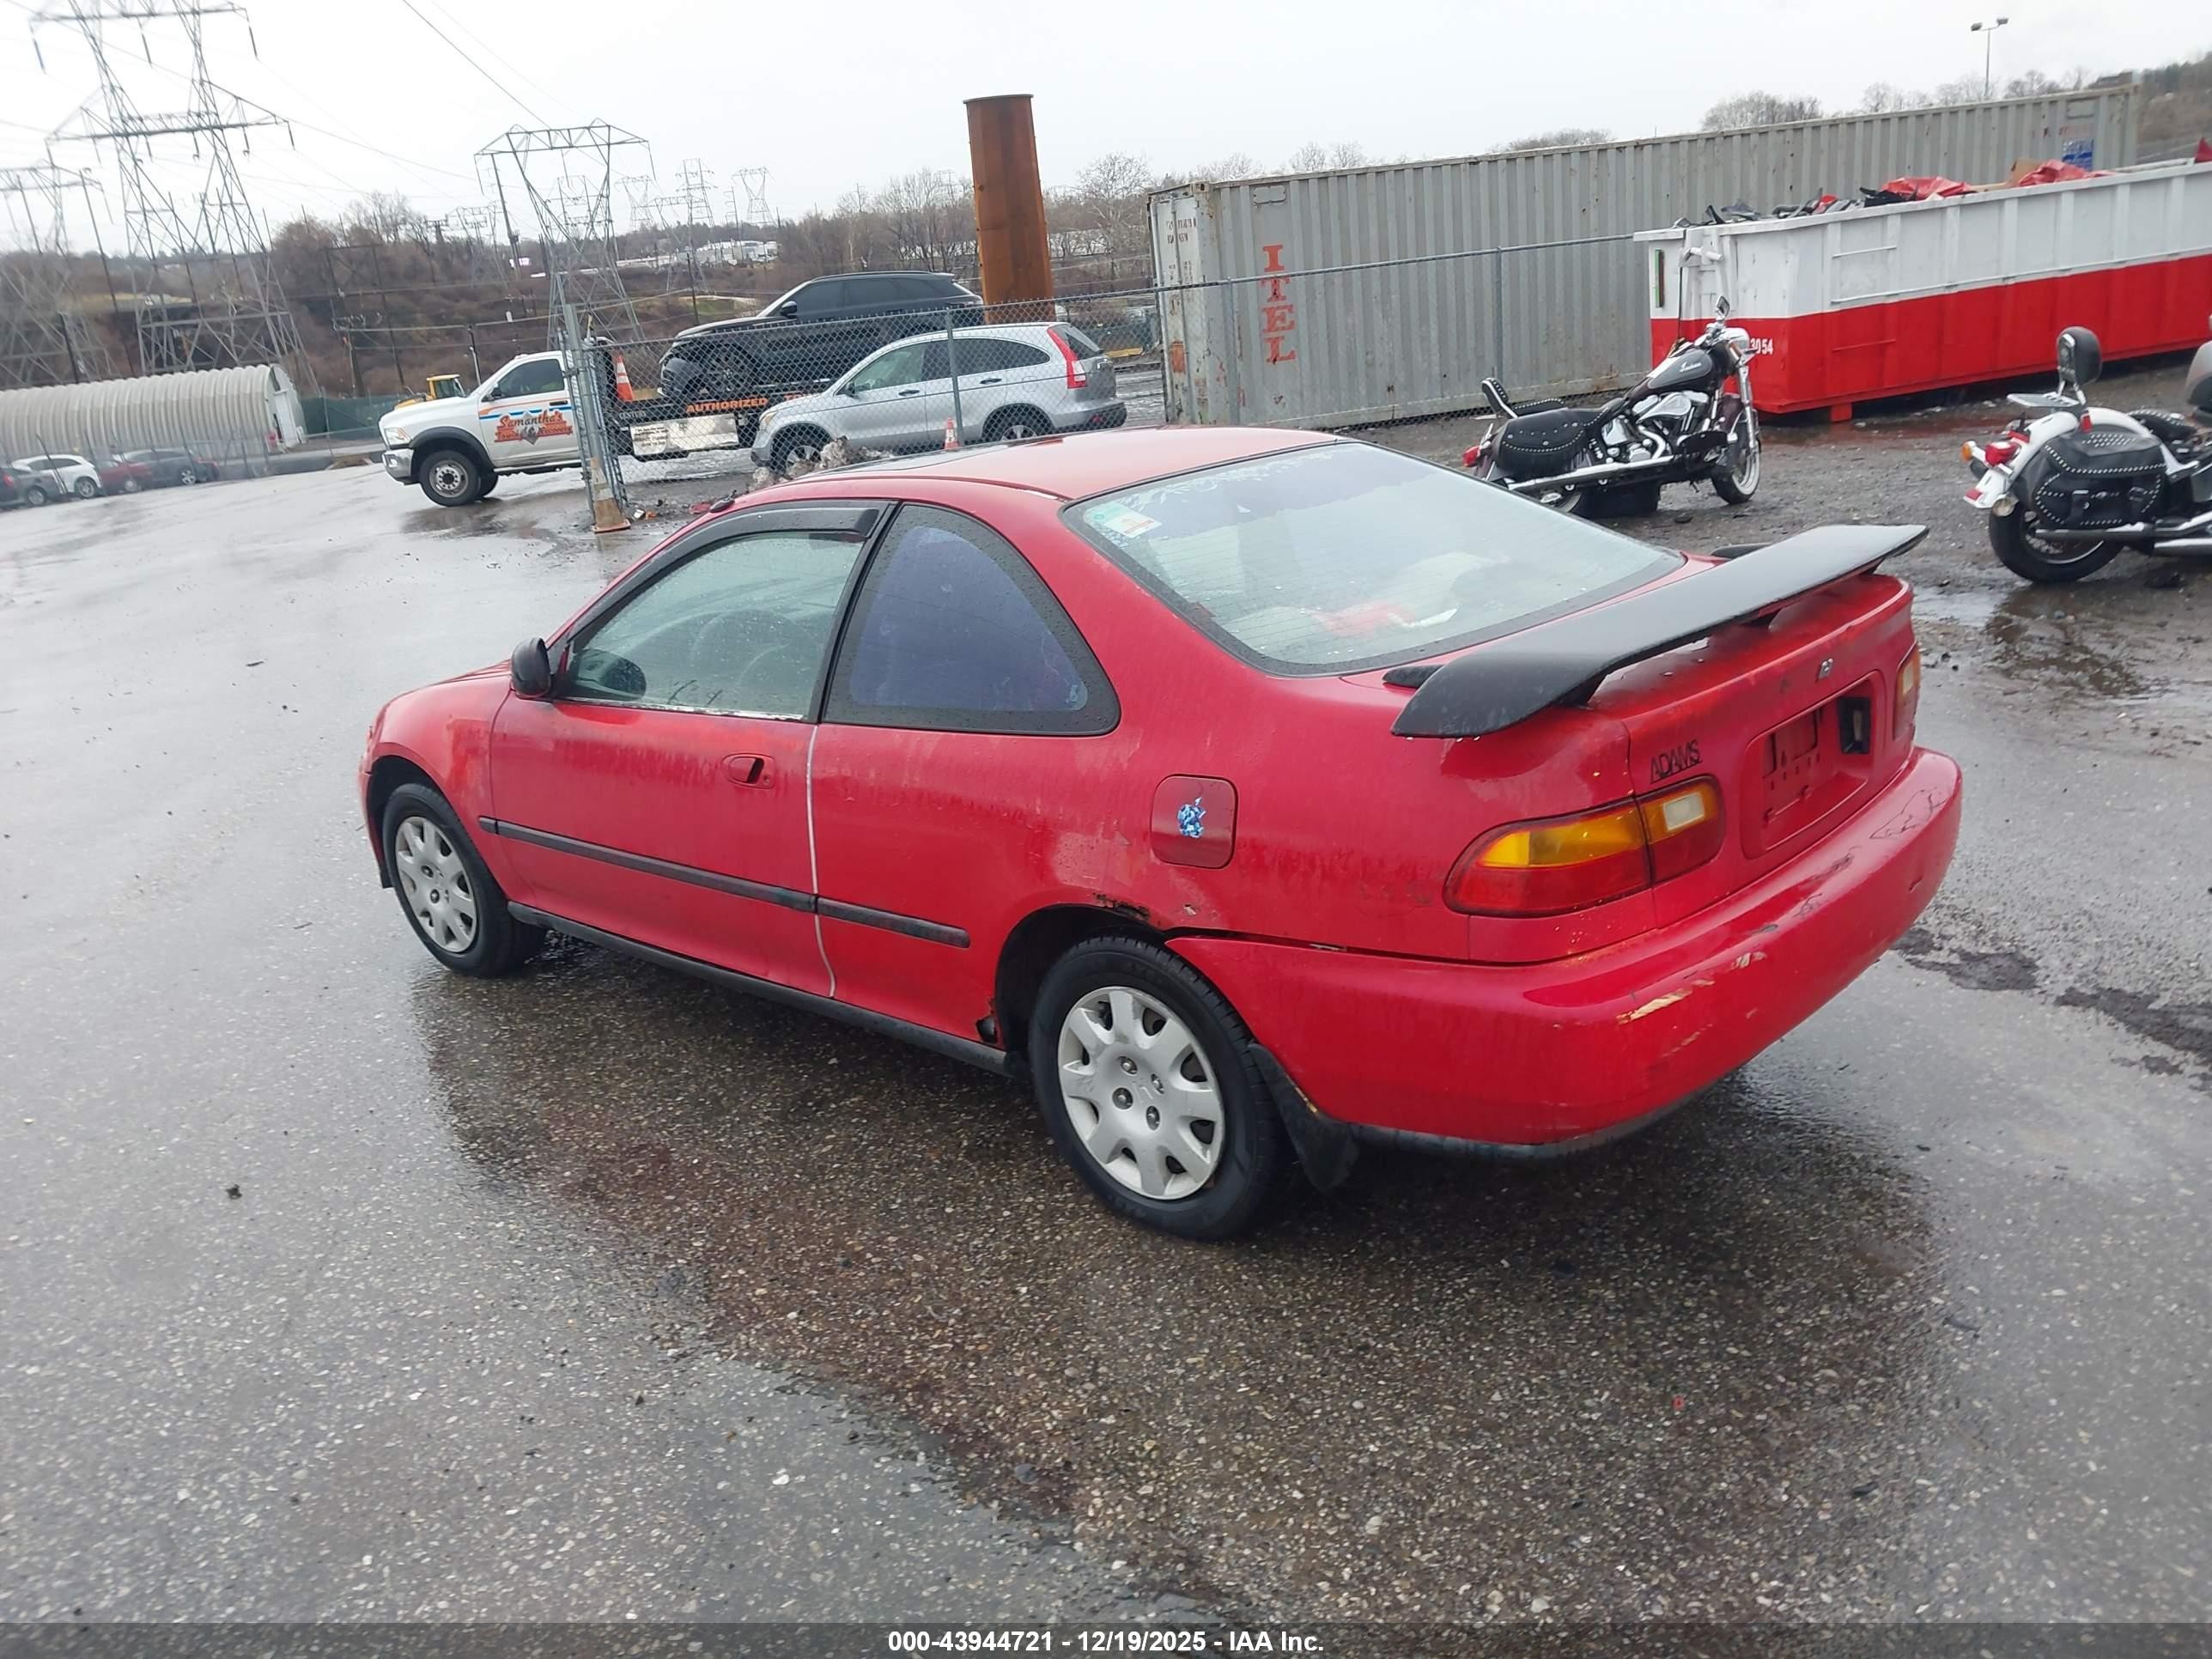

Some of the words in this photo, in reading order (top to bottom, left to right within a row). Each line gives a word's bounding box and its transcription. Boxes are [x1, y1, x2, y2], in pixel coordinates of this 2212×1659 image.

[1260, 244, 1297, 363] ITEL
[500, 409, 562, 428] Samantha's
[687, 398, 768, 413] AUTHORIZED
[1650, 738, 1702, 784] ADAMS
